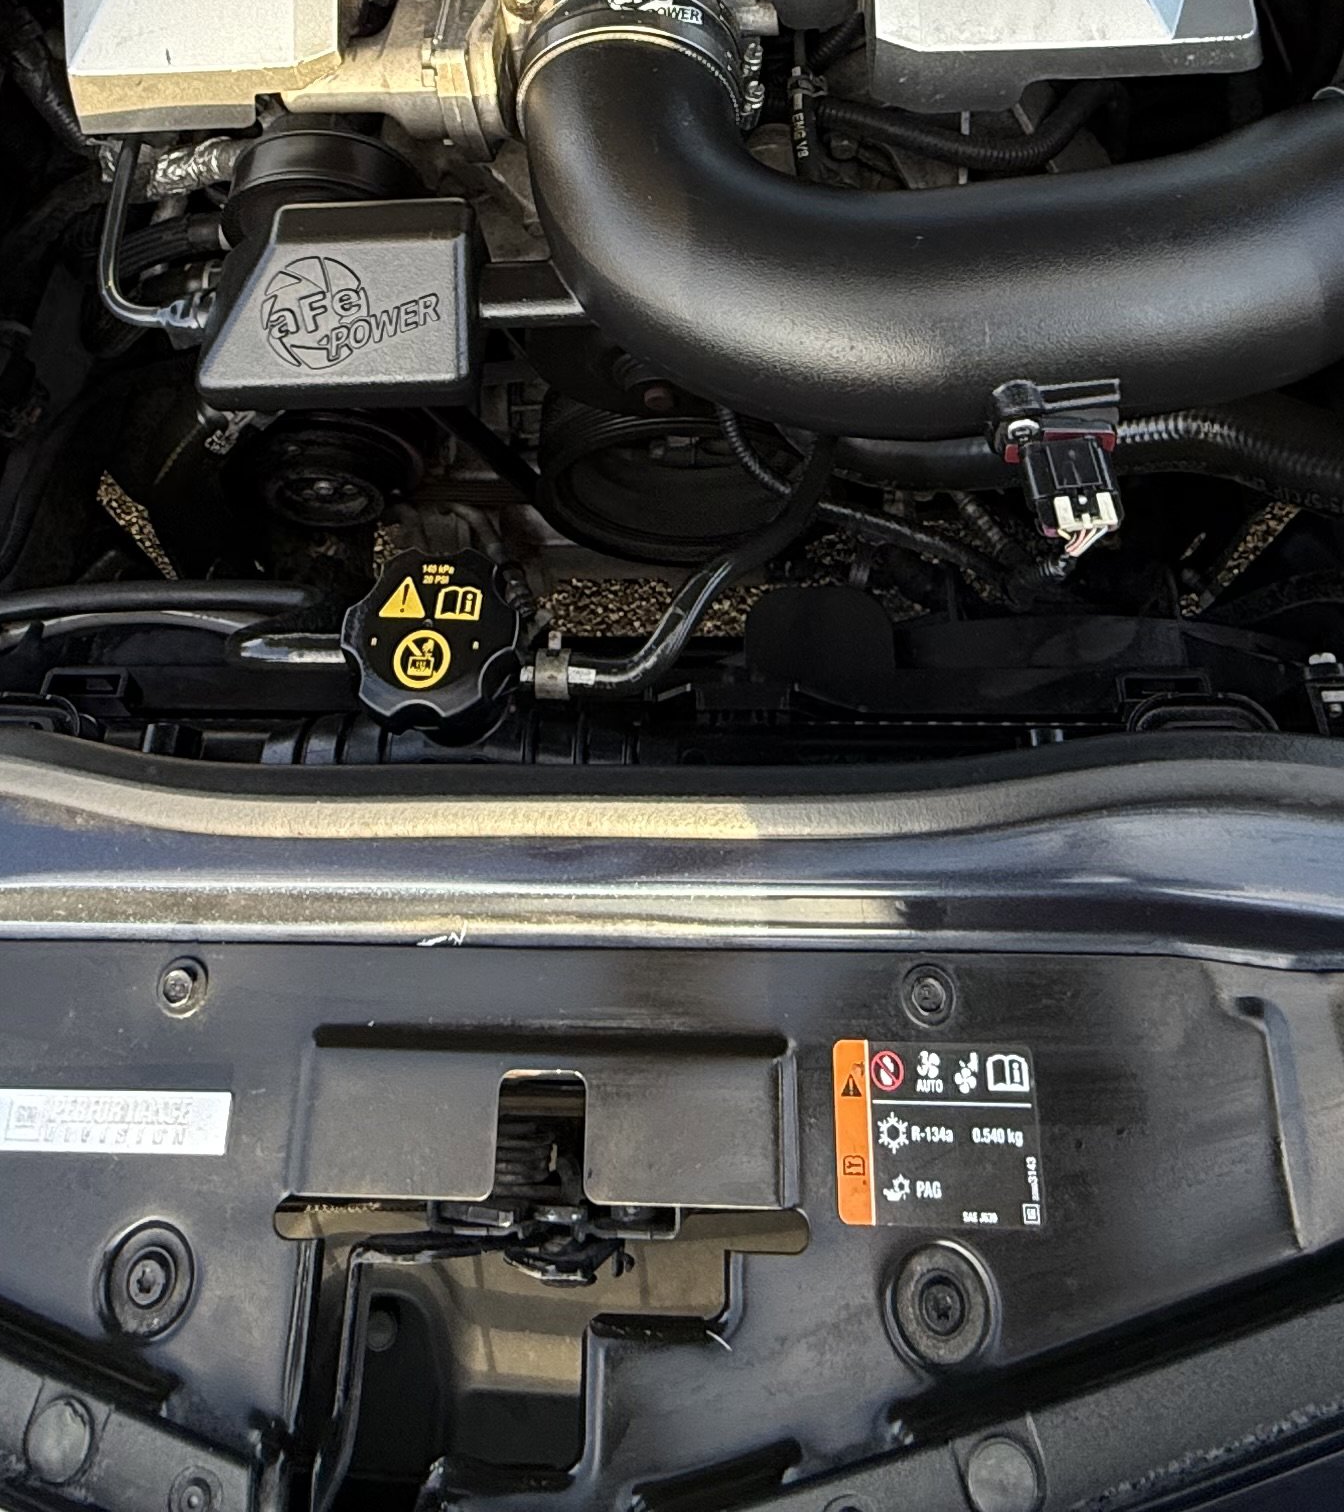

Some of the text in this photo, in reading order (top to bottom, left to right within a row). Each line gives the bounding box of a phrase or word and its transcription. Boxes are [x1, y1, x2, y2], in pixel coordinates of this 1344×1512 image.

[267, 288, 362, 339] aFe
[326, 292, 441, 361] POWER
[434, 574, 450, 585] PSI
[916, 1079, 944, 1094] AUTO
[42, 1124, 187, 1145] DIVISION
[911, 1126, 1024, 1148] R-134a 0.540 kg
[916, 1181, 942, 1199] PAG
